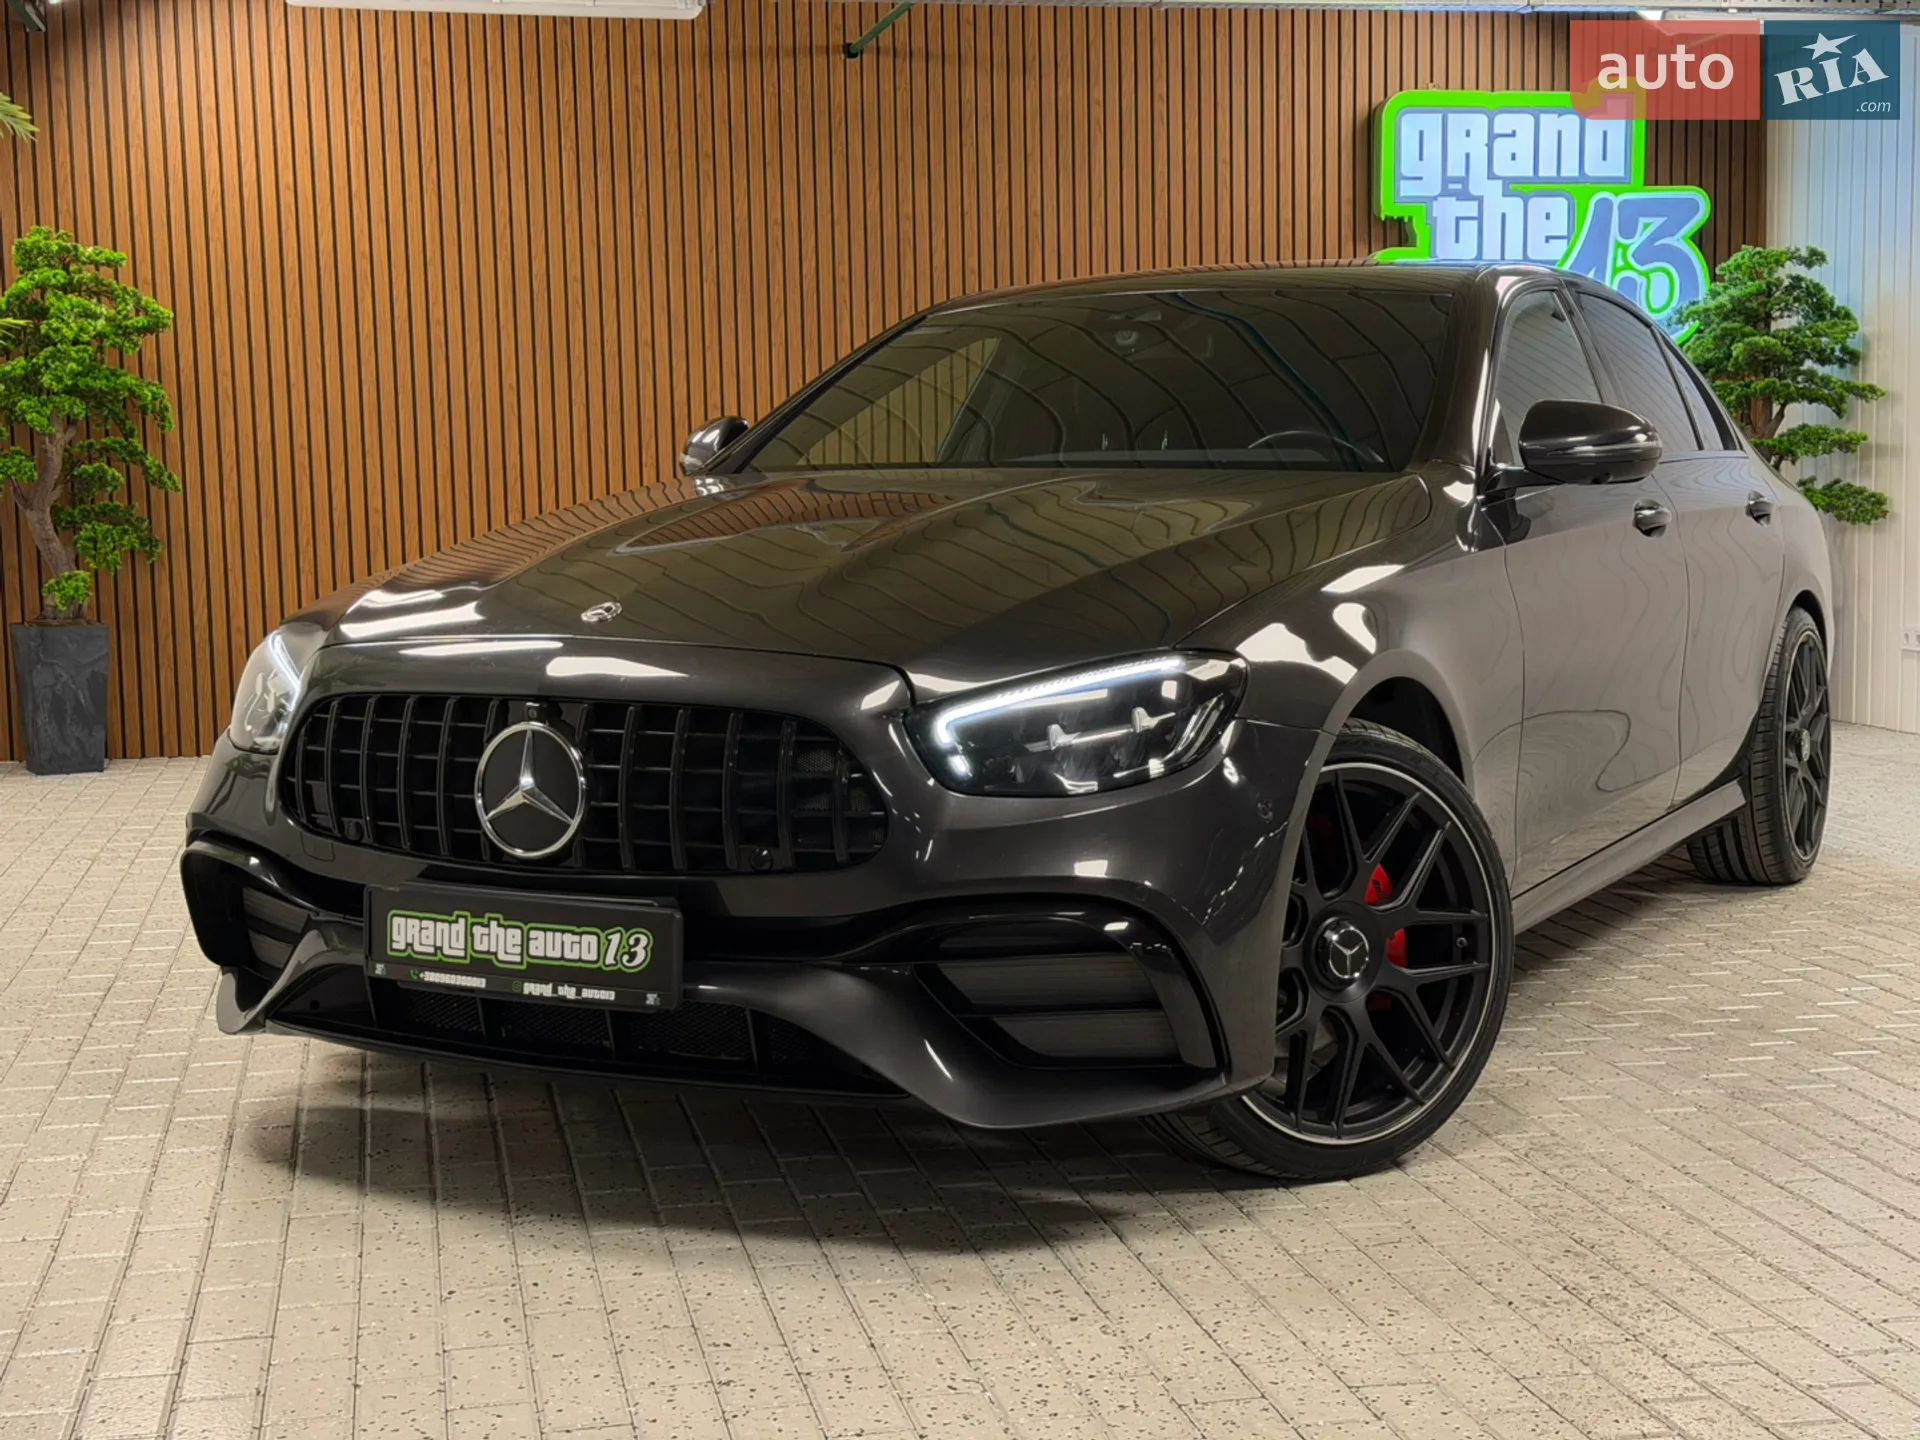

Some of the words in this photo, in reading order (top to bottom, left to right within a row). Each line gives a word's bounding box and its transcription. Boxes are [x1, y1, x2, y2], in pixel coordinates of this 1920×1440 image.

[1433, 180, 1569, 261] the
[472, 920, 523, 963] the
[529, 929, 599, 962] auto
[603, 932, 650, 967] 13
